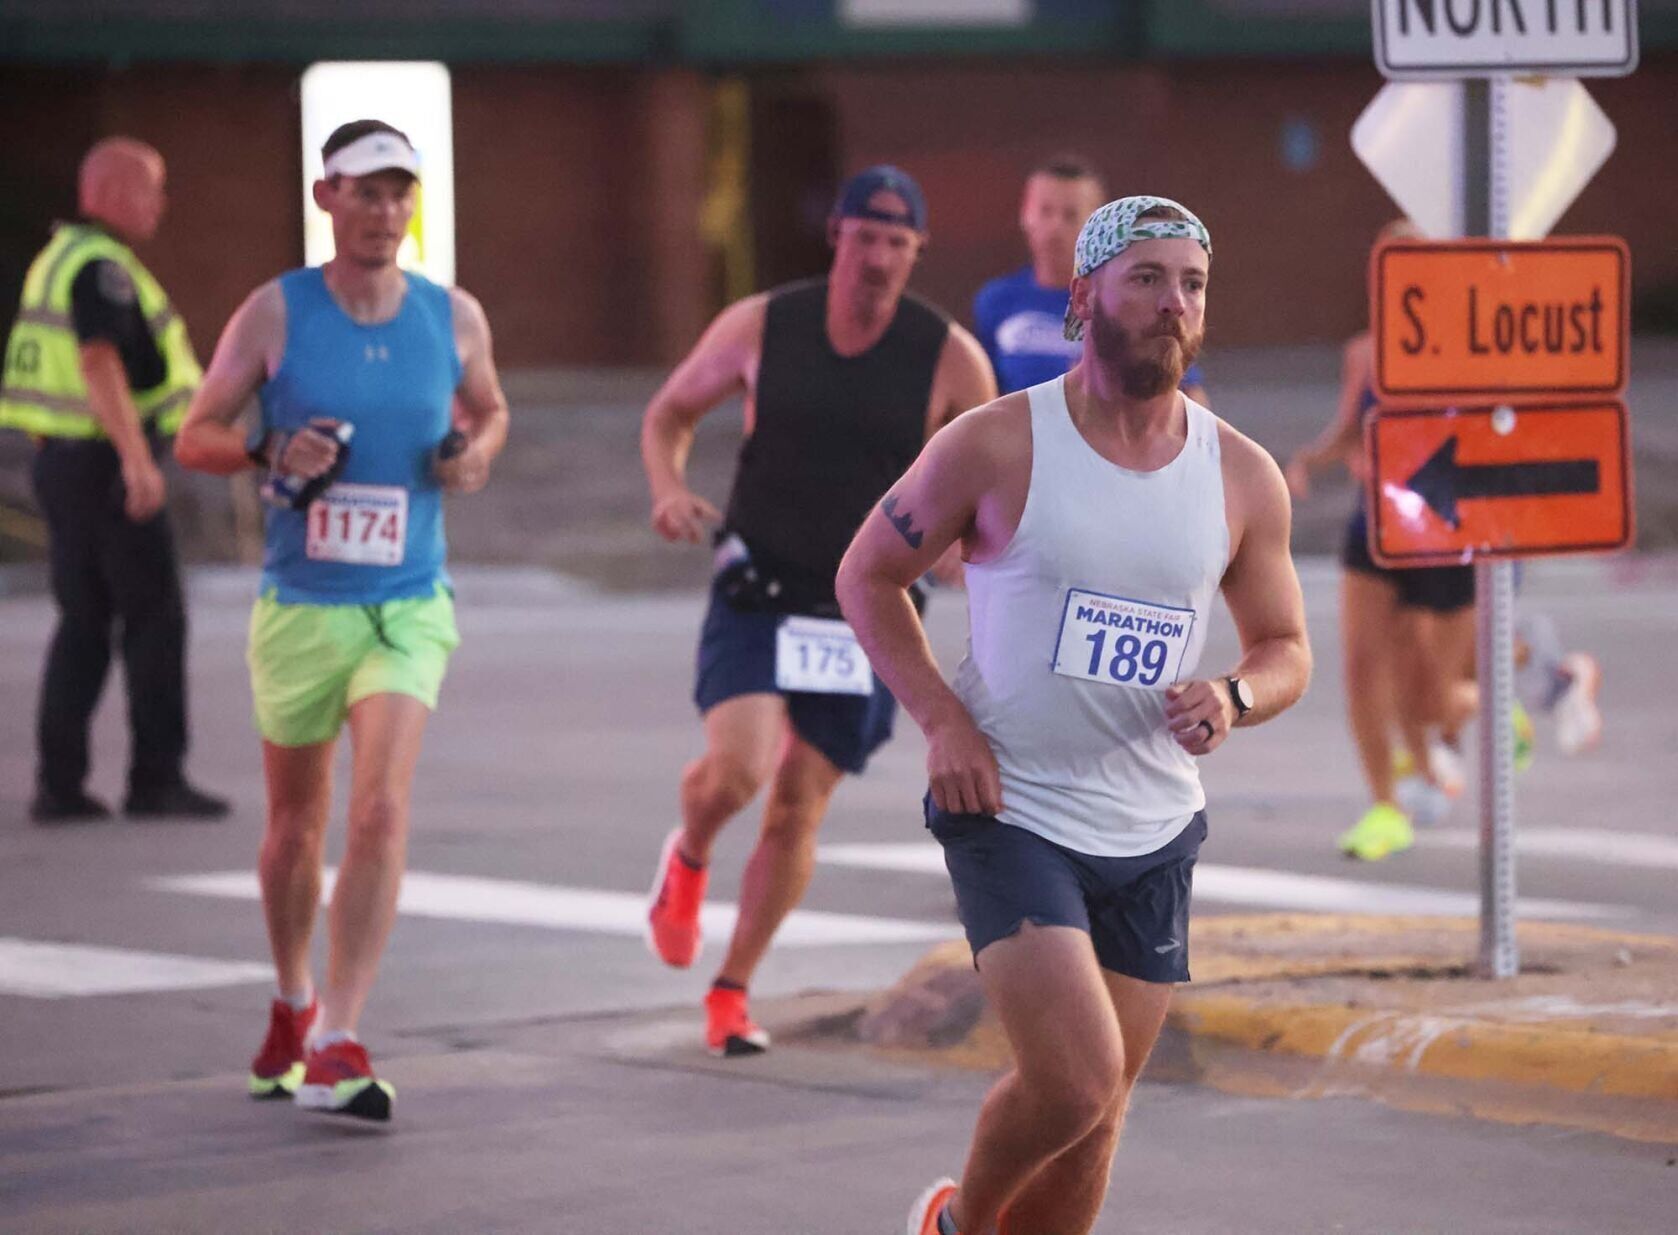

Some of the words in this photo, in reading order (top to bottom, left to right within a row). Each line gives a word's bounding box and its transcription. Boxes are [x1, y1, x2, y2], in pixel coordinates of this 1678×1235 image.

[1400, 285, 1441, 355] S.
[1468, 285, 1603, 354] Locust
[317, 508, 397, 543] 1174
[1076, 605, 1184, 638] MARATHON
[1089, 598, 1135, 615] NEBRASKA
[1137, 607, 1162, 620] STATE
[799, 643, 855, 678] 175
[1086, 629, 1168, 686] 189
